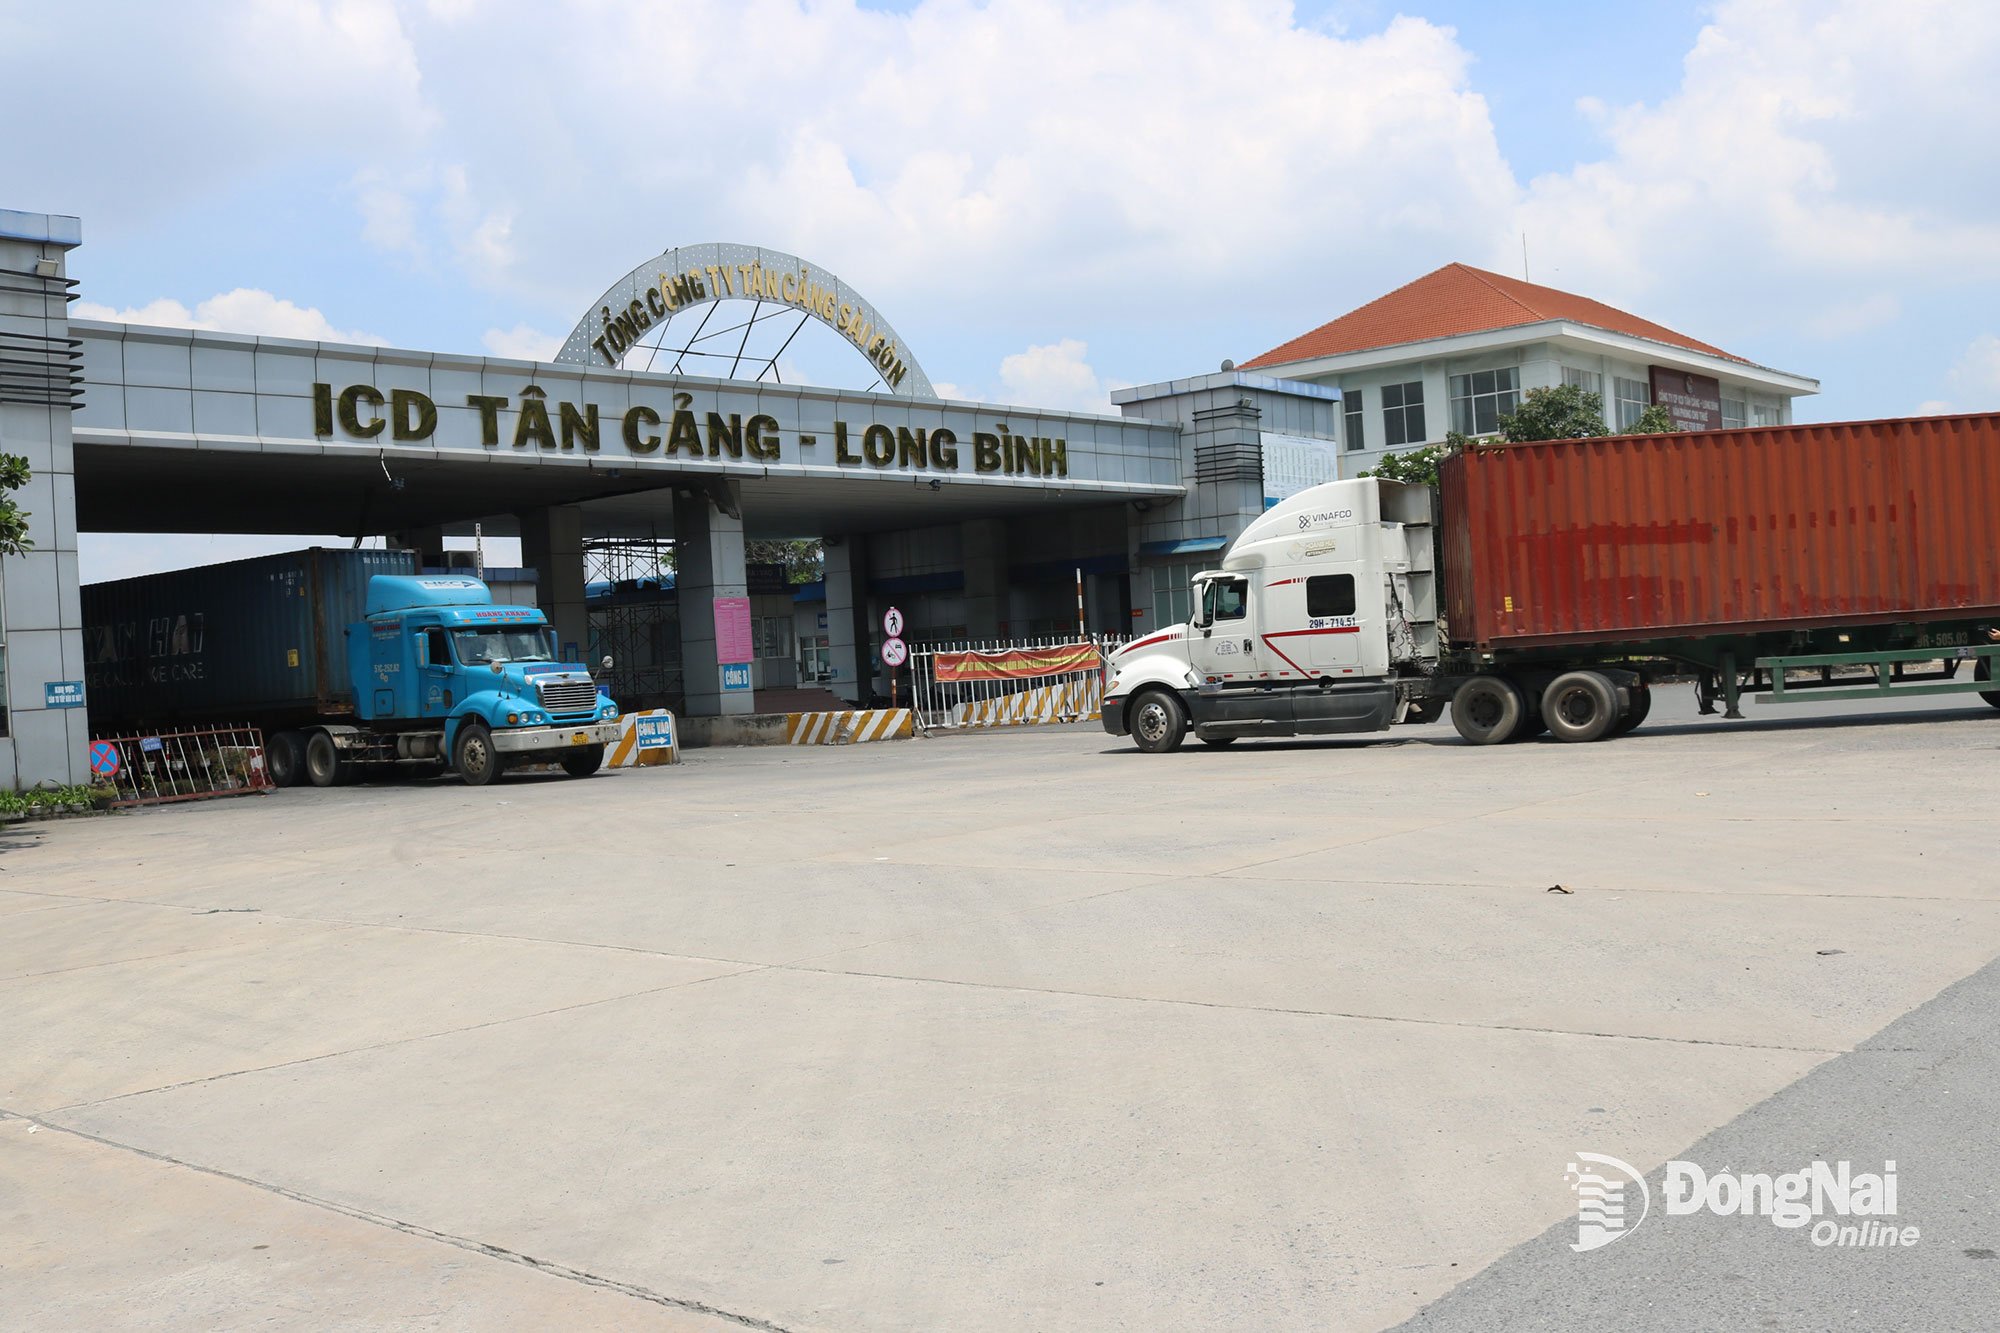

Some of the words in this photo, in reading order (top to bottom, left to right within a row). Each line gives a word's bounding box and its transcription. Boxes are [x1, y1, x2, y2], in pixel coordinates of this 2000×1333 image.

[592, 300, 652, 366] TỔNG
[647, 269, 706, 319] CÔNG
[705, 265, 734, 298] TY
[738, 259, 779, 300] TÂN
[781, 268, 837, 322] CẢNG
[836, 305, 874, 348] SÀI
[313, 382, 438, 441] ICD
[467, 385, 601, 451] TÂN
[622, 391, 781, 460] CẢNG
[834, 421, 959, 470] LONG
[973, 424, 1068, 477] BÌNH
[1312, 510, 1352, 522] VINAFCO
[1309, 619, 1324, 628] 29H
[1330, 617, 1355, 627] 714.51
